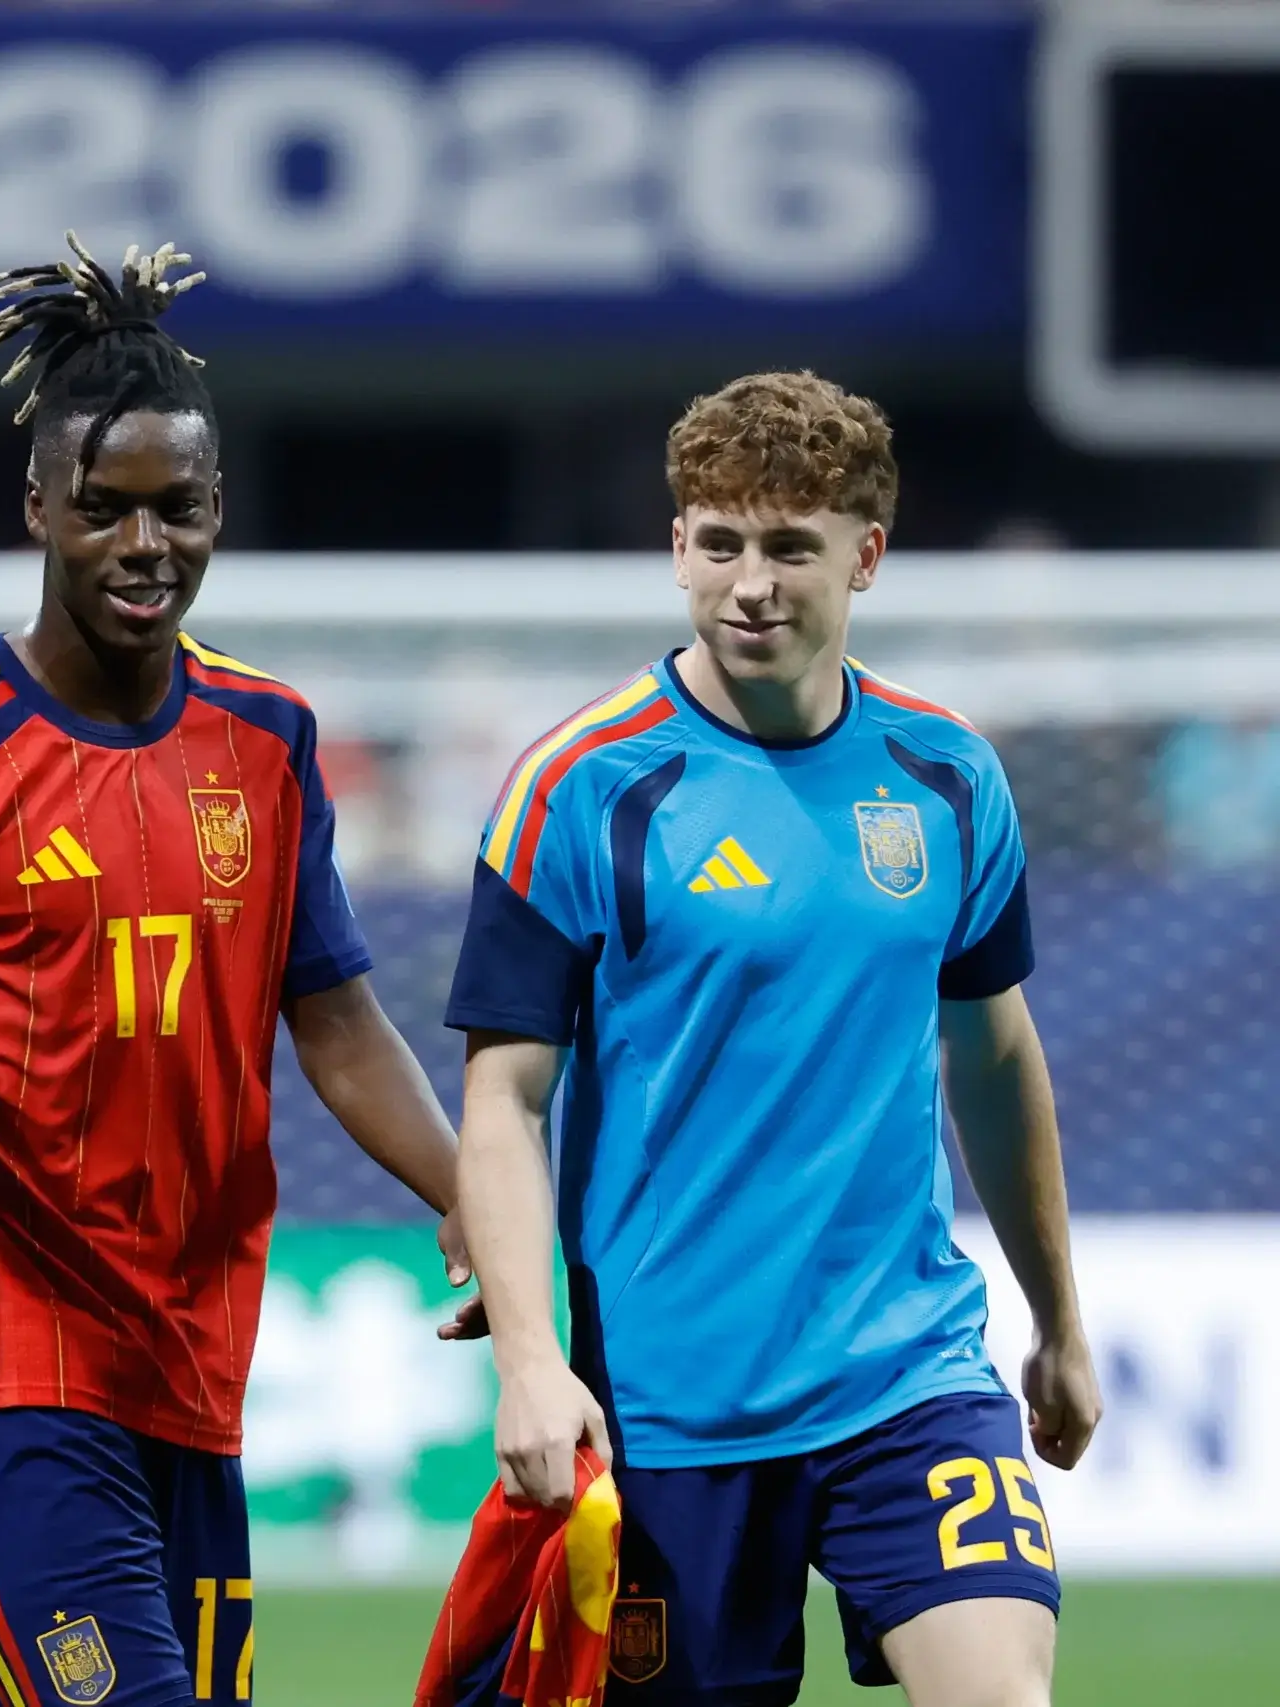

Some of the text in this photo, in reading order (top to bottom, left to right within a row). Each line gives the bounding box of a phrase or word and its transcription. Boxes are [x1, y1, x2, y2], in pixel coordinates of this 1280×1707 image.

[107, 914, 192, 1038] 17
[927, 1456, 1054, 1571] 25
[194, 1577, 254, 1700] 17
